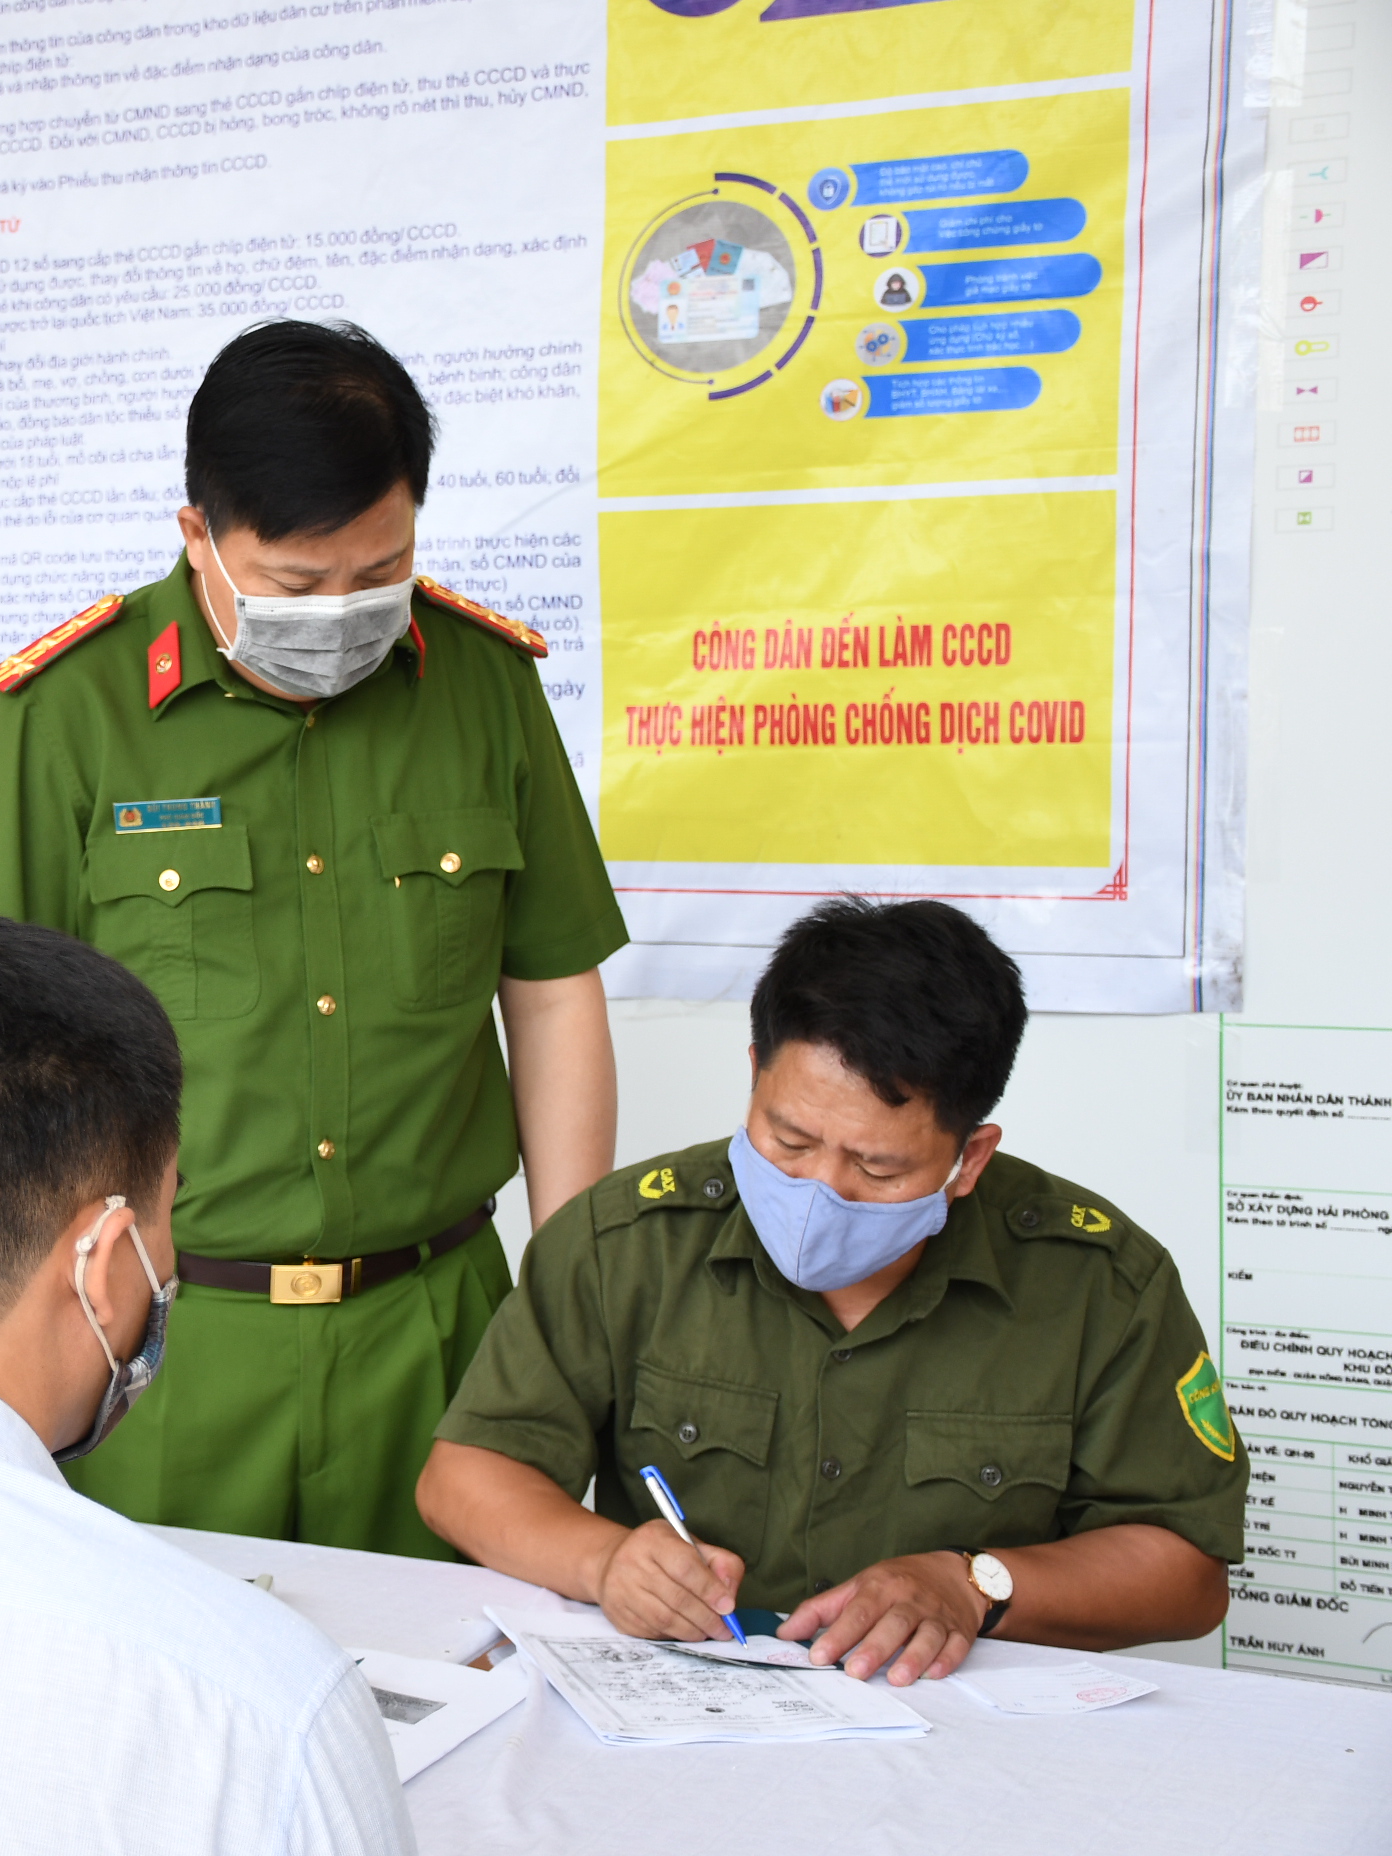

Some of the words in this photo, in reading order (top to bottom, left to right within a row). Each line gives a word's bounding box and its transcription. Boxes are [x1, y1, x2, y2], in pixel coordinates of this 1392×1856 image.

[473, 65, 526, 86] CCCD
[530, 64, 550, 79] và
[552, 234, 587, 250] định
[437, 473, 456, 488] 40
[494, 470, 515, 486] 60
[551, 532, 581, 547] các
[469, 553, 490, 570] số
[492, 553, 548, 570] CMND
[551, 551, 582, 568] của
[504, 593, 524, 611] số
[527, 594, 583, 610] CMND
[692, 622, 756, 672] CÔNG
[764, 619, 812, 669] DÂN
[820, 613, 869, 669] ĐẾN
[878, 616, 932, 668] LÀM
[942, 622, 1012, 667] CCCD
[626, 700, 683, 756] THỰC
[690, 696, 745, 756] HIỆN
[752, 693, 836, 746] PHÒNG
[844, 686, 930, 746] CHỐNG
[939, 702, 1000, 755] DỊCH
[1009, 700, 1086, 745] COVID
[1247, 1092, 1273, 1102] BAN
[1277, 1092, 1312, 1104] NHÂN
[1317, 1093, 1343, 1105] DÂN
[1348, 1094, 1392, 1107] THÀNH
[1248, 1202, 1273, 1213] XÂY
[1277, 1204, 1313, 1217] DỰNG
[1317, 1205, 1338, 1217] HẢI
[1343, 1208, 1389, 1220] PHÒNG
[1240, 1340, 1270, 1351] ĐIỀU
[1273, 1341, 1313, 1355] CHỈNH
[1317, 1346, 1343, 1357] QUY
[1343, 1363, 1370, 1374] KHU
[1280, 1410, 1307, 1422] QUY
[1311, 1413, 1357, 1427] HOẠCH
[1359, 1508, 1387, 1518] MINH
[1359, 1533, 1387, 1543] MINH
[1362, 1559, 1389, 1569] MINH
[1230, 1584, 1270, 1603] TỔNG
[1274, 1593, 1312, 1608] GIÁM
[1317, 1595, 1349, 1612] ĐỐC
[1230, 1635, 1264, 1649] TRẦN
[1267, 1639, 1294, 1652] HUY
[1297, 1644, 1325, 1657] ÁNH
